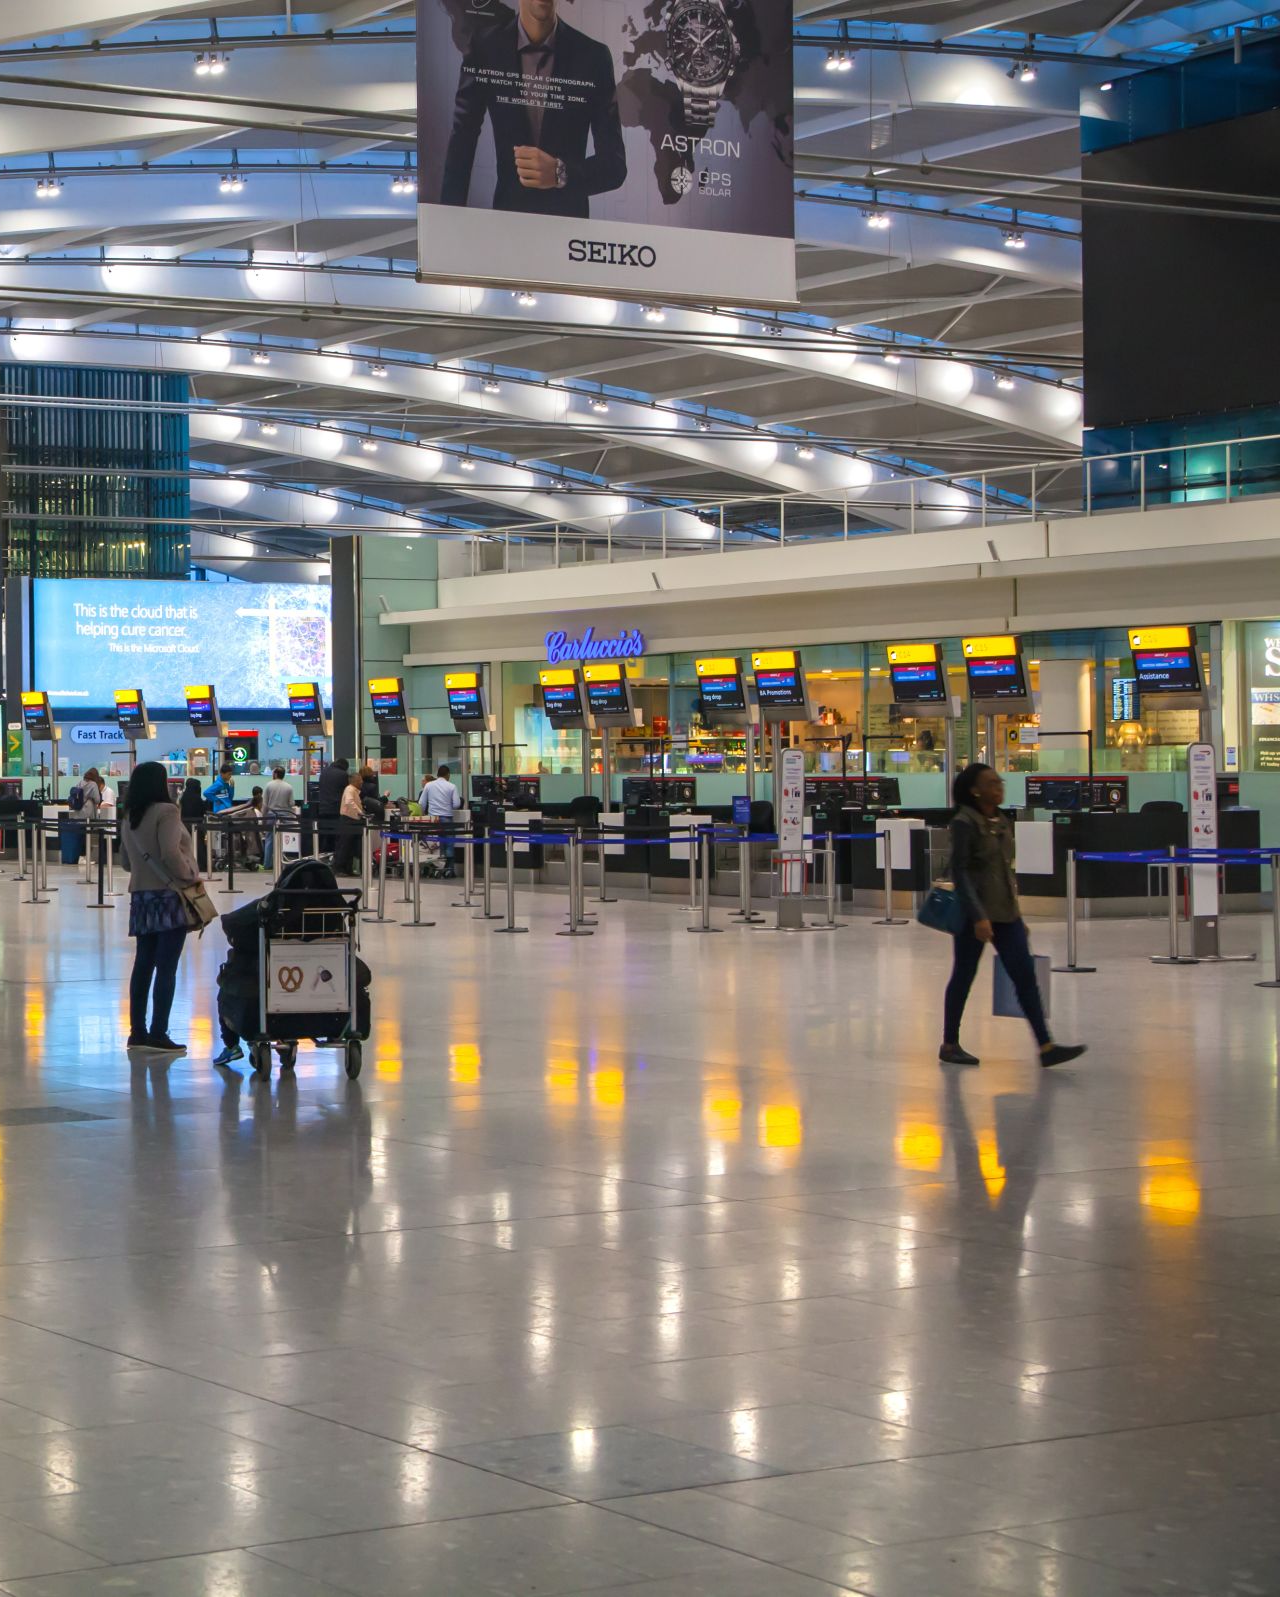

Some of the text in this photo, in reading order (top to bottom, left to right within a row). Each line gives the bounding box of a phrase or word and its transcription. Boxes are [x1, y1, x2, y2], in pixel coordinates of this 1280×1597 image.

[478, 68, 504, 77] ASTRON
[522, 73, 543, 81] SOLAR
[491, 78, 513, 86] WATCH
[531, 91, 548, 99] YOUR
[660, 134, 740, 158] ASTRON
[698, 171, 731, 186] GPS
[698, 187, 731, 198] SOLAR
[568, 239, 657, 268] SEIKO
[73, 603, 198, 620] This is the cloud that is
[76, 621, 188, 639] helping cure cancer.
[109, 643, 123, 653] This
[130, 643, 143, 653] the
[143, 643, 177, 653] Microsoft
[544, 627, 643, 665] Carluccio's
[1139, 672, 1170, 680] Assistance
[77, 730, 123, 740] Fast Track
